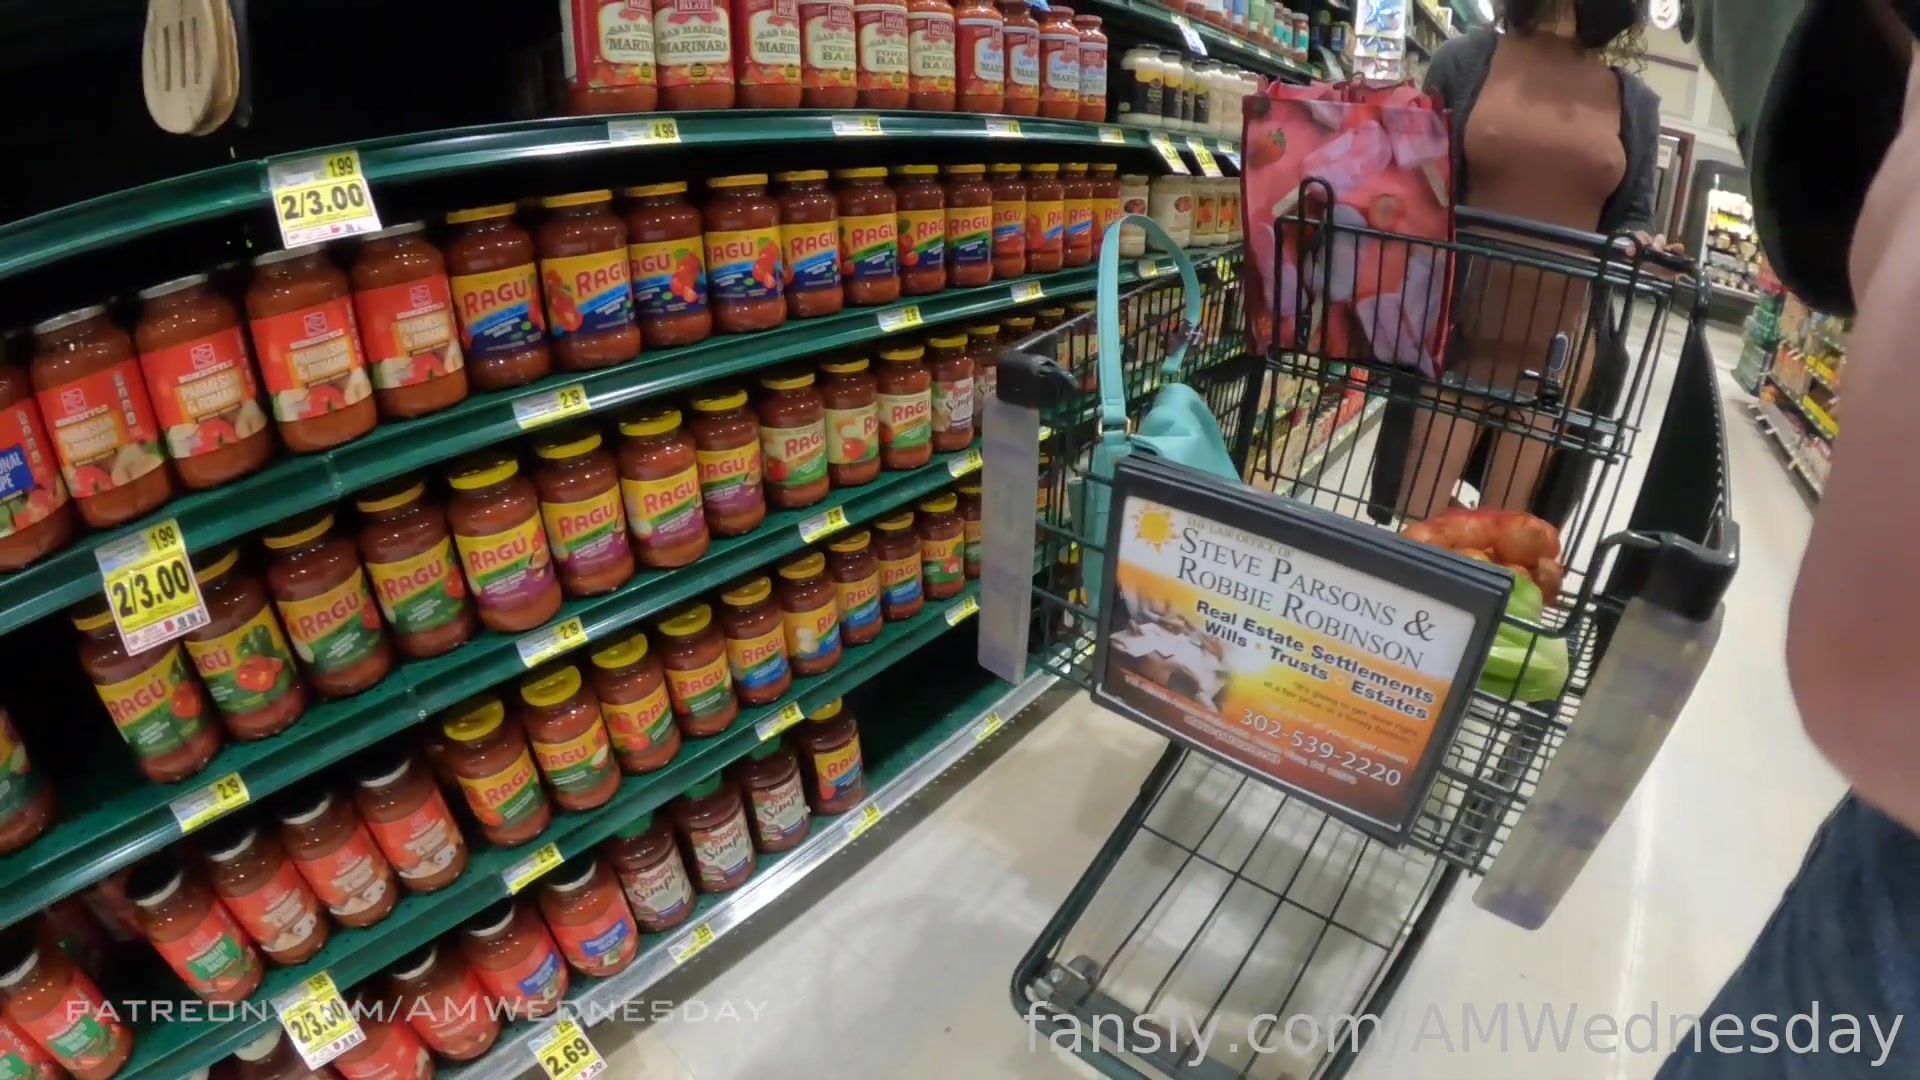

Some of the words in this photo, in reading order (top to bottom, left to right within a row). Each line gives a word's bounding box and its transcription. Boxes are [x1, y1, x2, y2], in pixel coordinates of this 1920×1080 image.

[281, 183, 364, 220] 2/3.00
[113, 560, 191, 618] 2/3.00
[1177, 556, 1275, 612] ROBBIE
[1281, 592, 1425, 670] ROBINSON
[1180, 527, 1262, 577] STEVE
[1269, 556, 1397, 627] PARSONS
[1403, 610, 1436, 642] &
[1196, 599, 1237, 627] Real
[1243, 617, 1304, 652] Estate
[1311, 644, 1435, 705] Settlements
[1205, 619, 1248, 648] Wills
[1270, 645, 1329, 681] Trusts
[1351, 679, 1429, 721] Estates
[1240, 708, 1401, 786] 302-539-2220
[546, 1037, 590, 1077] 2.69
